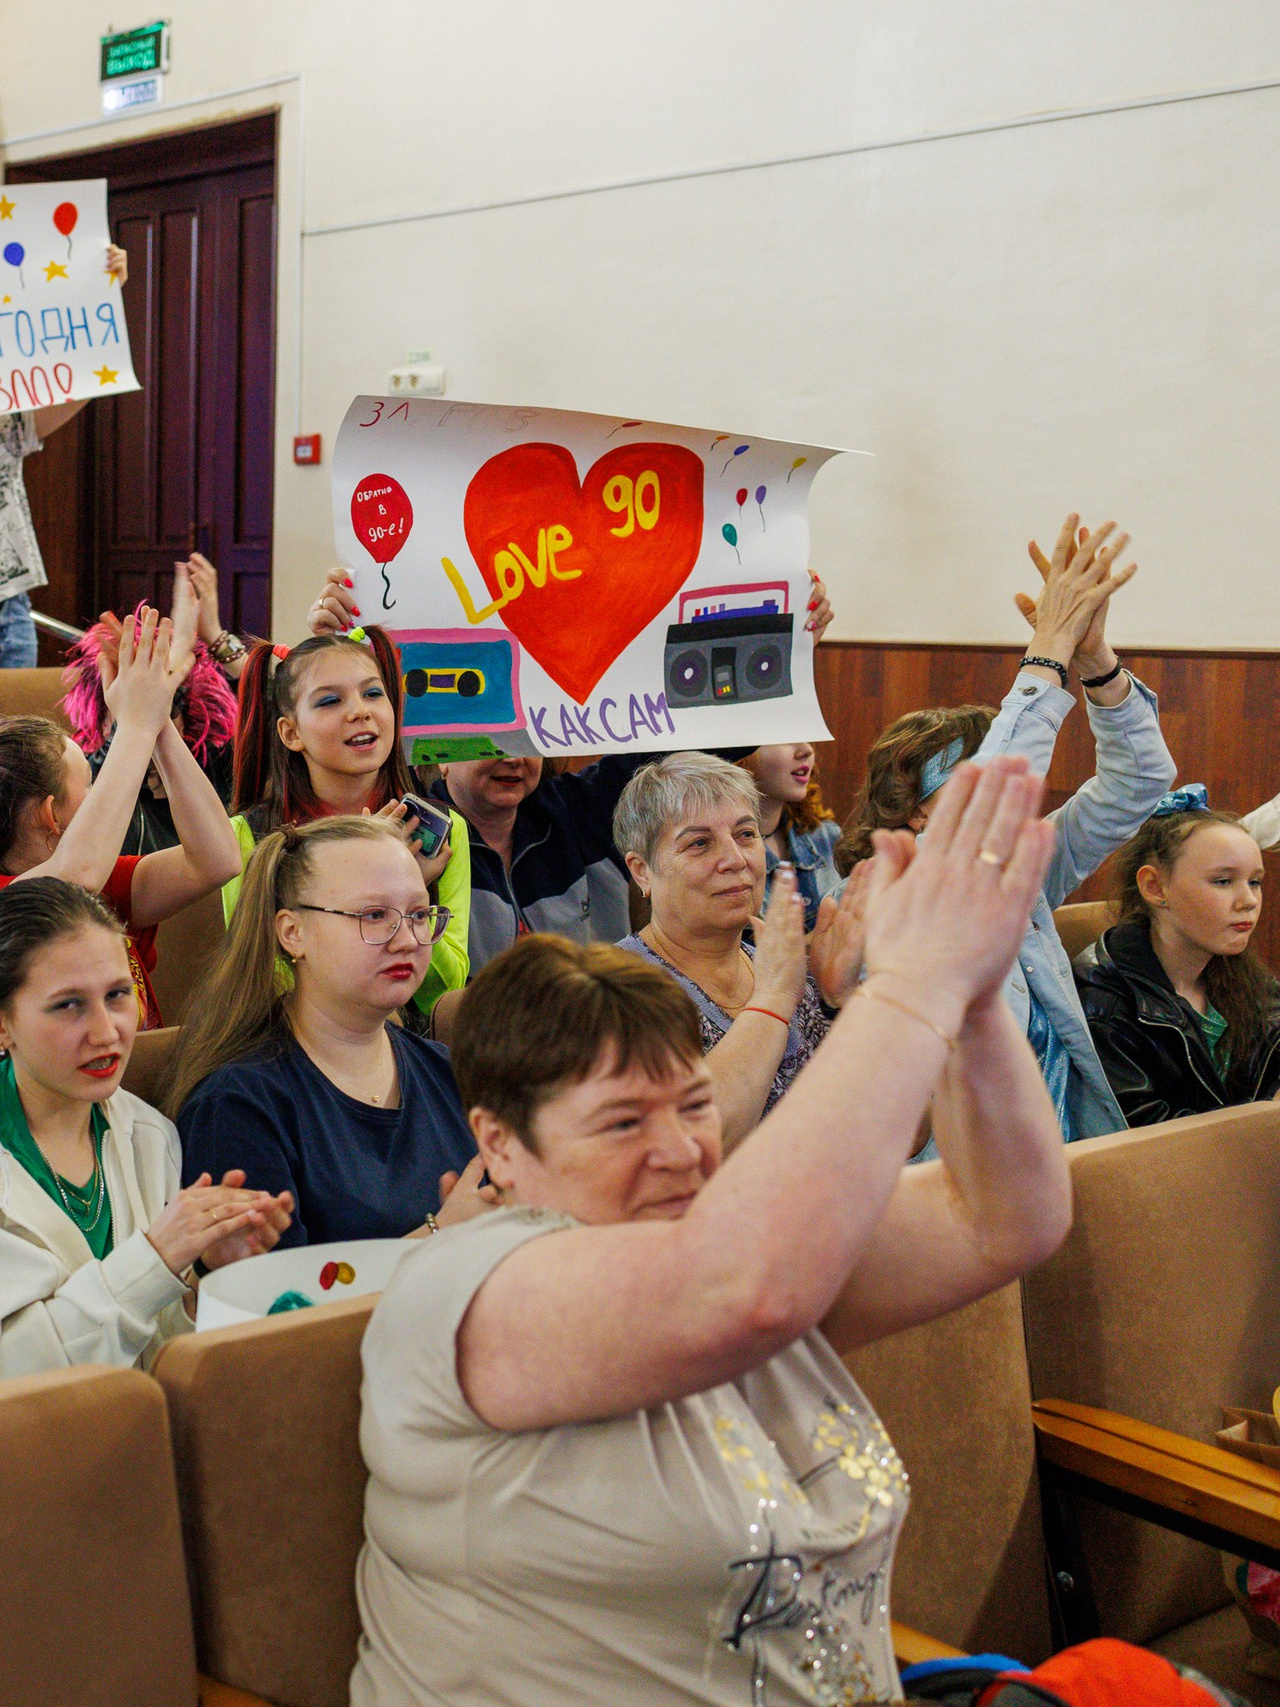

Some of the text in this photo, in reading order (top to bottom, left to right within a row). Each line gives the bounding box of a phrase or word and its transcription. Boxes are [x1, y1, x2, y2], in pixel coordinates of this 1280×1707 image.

[356, 485, 393, 503] ОБРАТНО
[378, 503, 387, 516] В
[601, 469, 661, 539] 90
